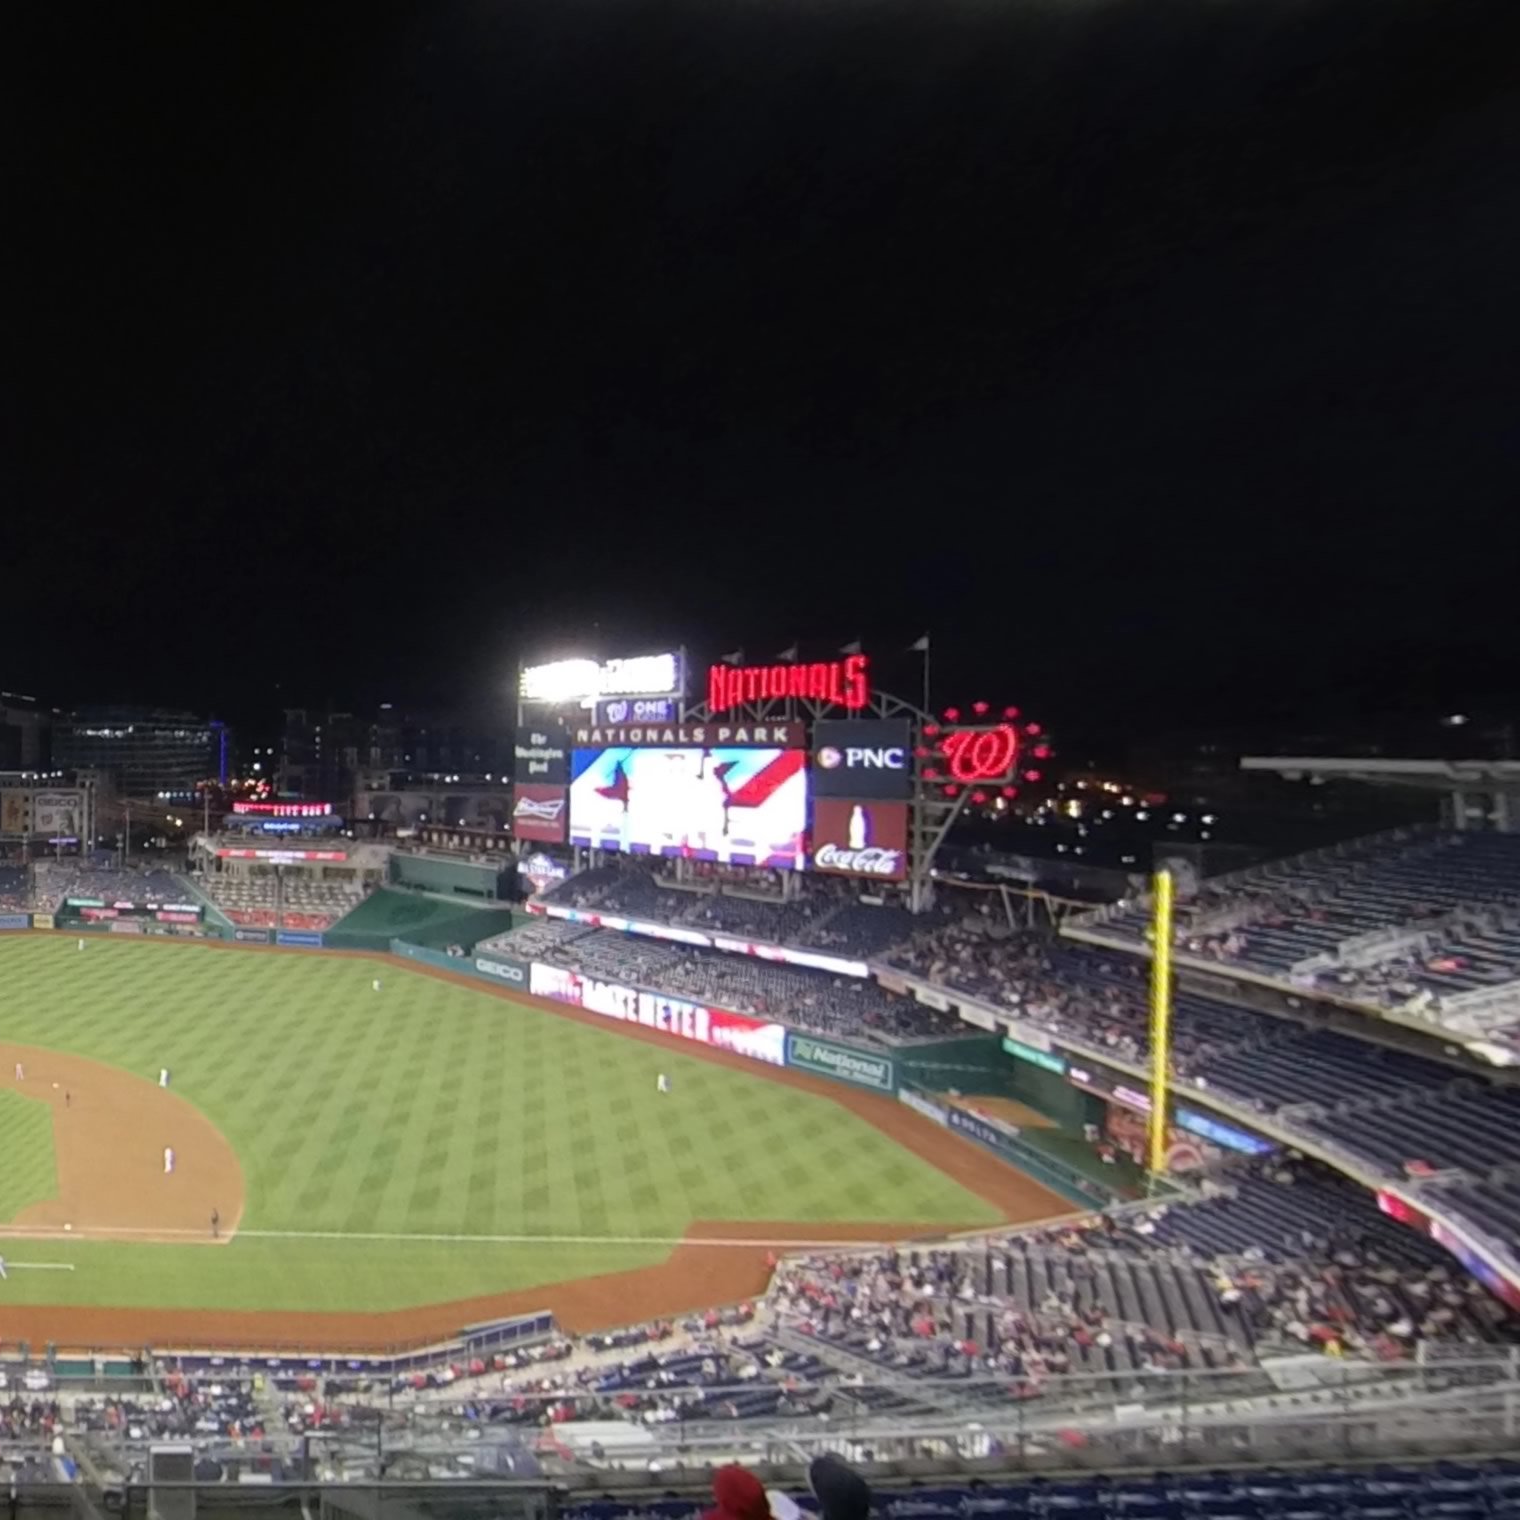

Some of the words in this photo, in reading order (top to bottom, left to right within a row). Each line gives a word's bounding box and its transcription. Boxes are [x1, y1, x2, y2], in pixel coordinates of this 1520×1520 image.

[709, 654, 867, 713] NATIONALS
[577, 728, 705, 743] NATIONALS
[718, 727, 788, 742] PARK
[846, 748, 904, 768] PNC
[476, 958, 523, 981] GEICO
[813, 1047, 886, 1077] National
